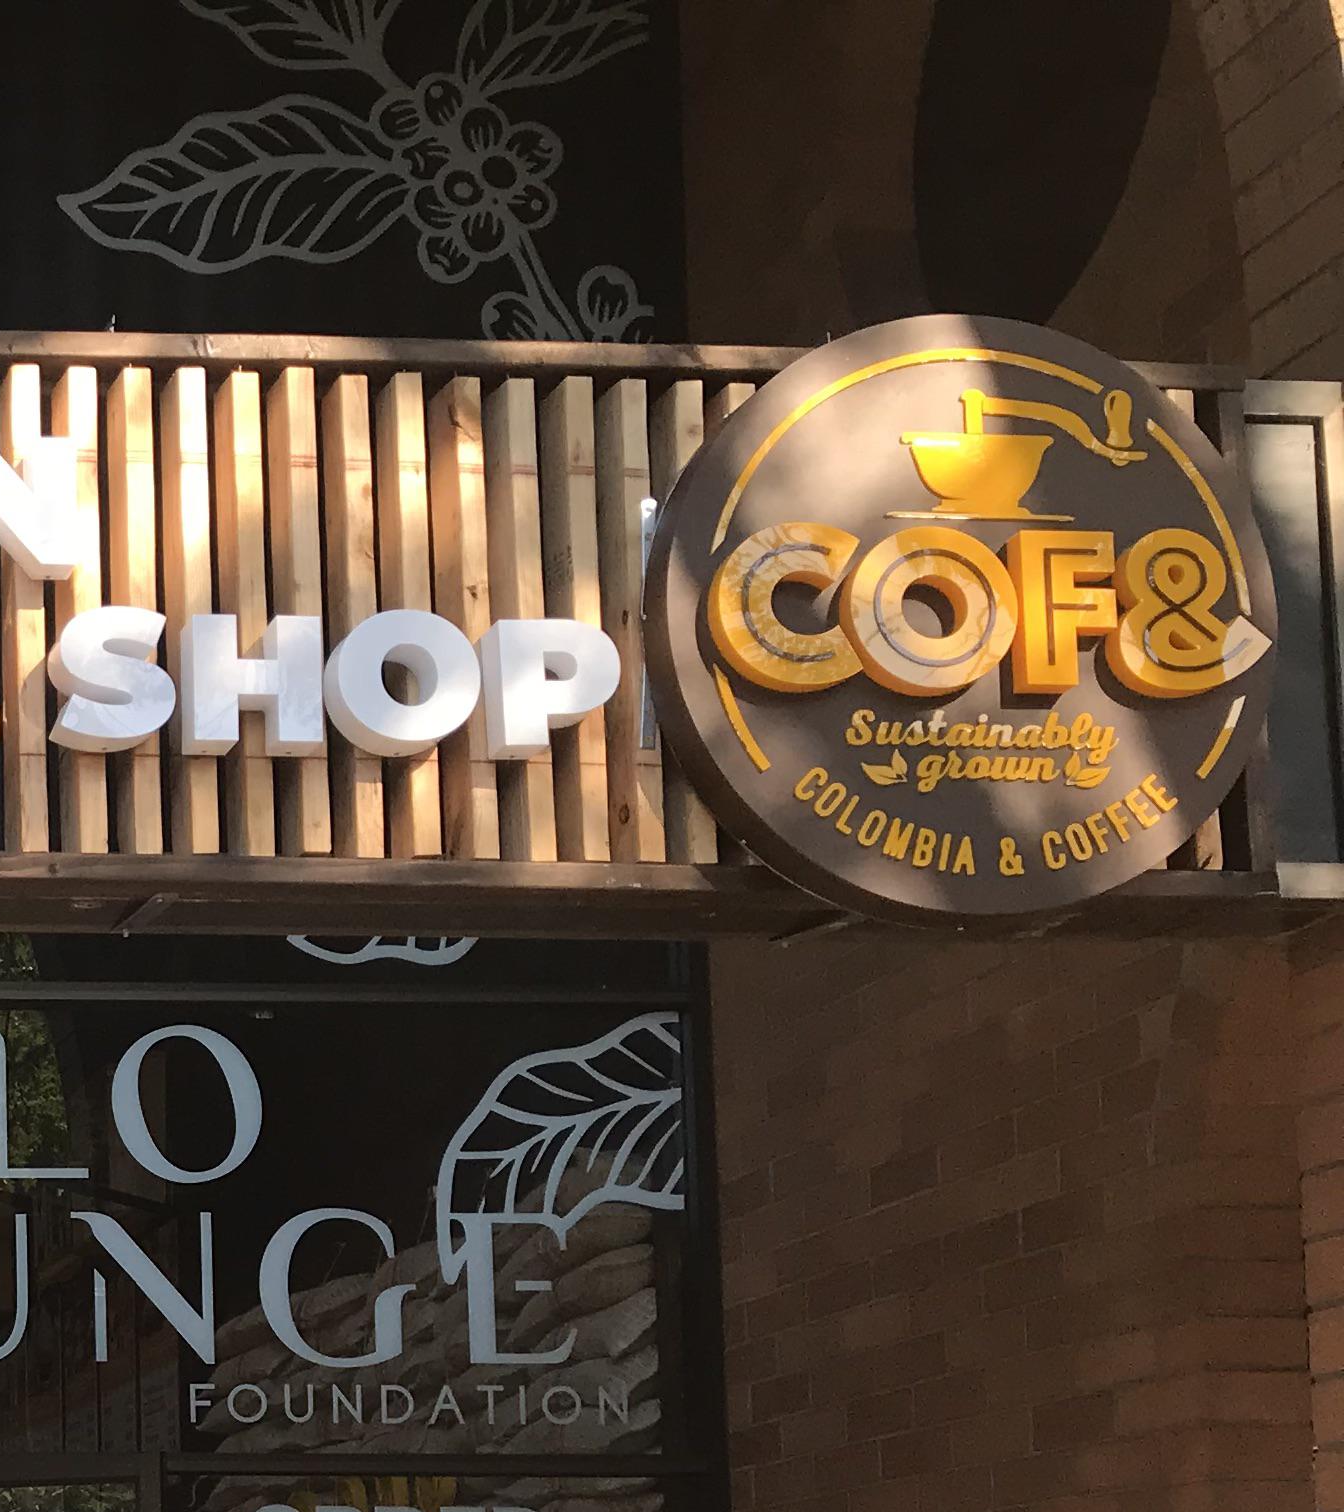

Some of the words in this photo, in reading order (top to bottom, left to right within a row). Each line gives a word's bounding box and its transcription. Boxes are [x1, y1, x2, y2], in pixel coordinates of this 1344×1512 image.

[48, 605, 622, 761] SHOP
[845, 709, 1120, 763] Sustainably
[915, 750, 1061, 791] grown
[793, 766, 976, 876] COLOMBIA
[998, 837, 1025, 876] &
[1041, 773, 1178, 872] COFFEE
[189, 1382, 631, 1426] FOUNDATION
